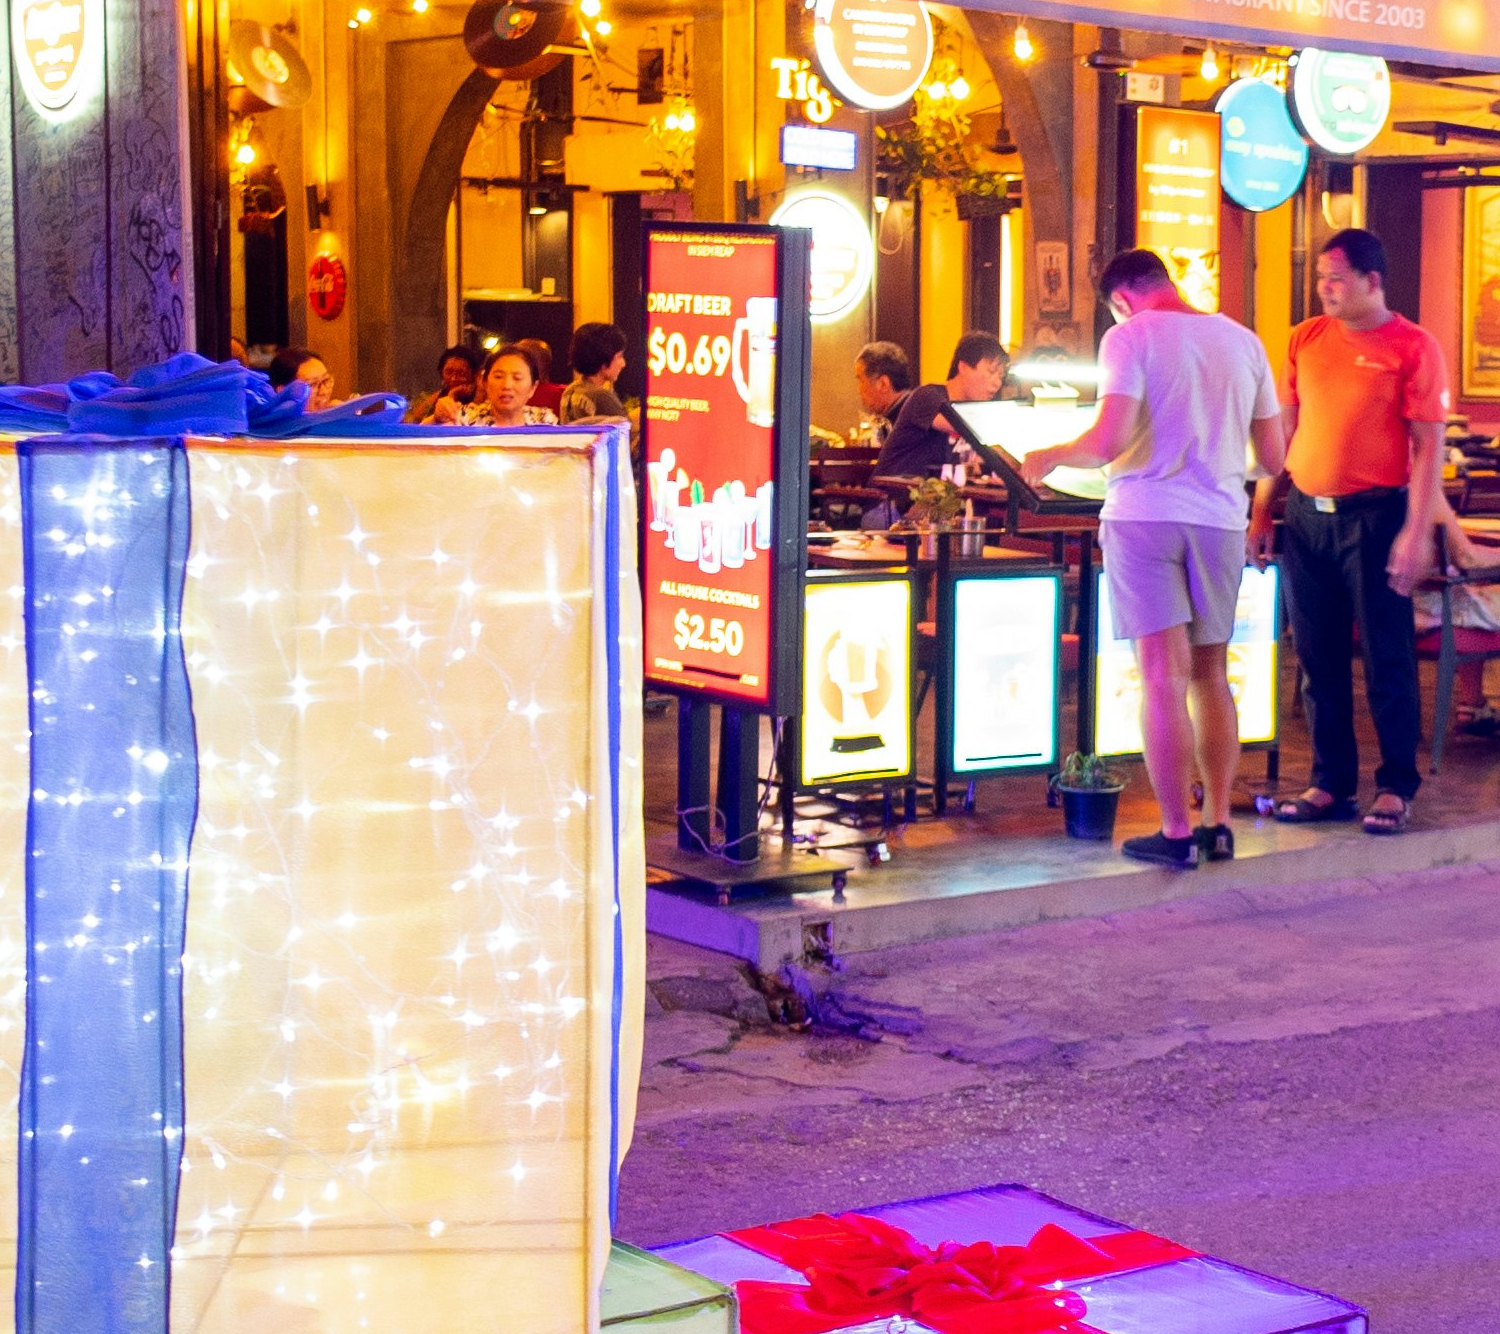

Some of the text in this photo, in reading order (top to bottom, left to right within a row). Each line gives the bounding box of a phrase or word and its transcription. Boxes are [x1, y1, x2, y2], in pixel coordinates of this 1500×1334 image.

[1377, 2, 1426, 30] 2003
[771, 57, 835, 124] Tig
[647, 293, 731, 316] DRAFT BEER
[648, 327, 731, 377] $0.69
[660, 580, 760, 609] ALL HOUSE COCKTAILS
[674, 608, 744, 657] $2.50
